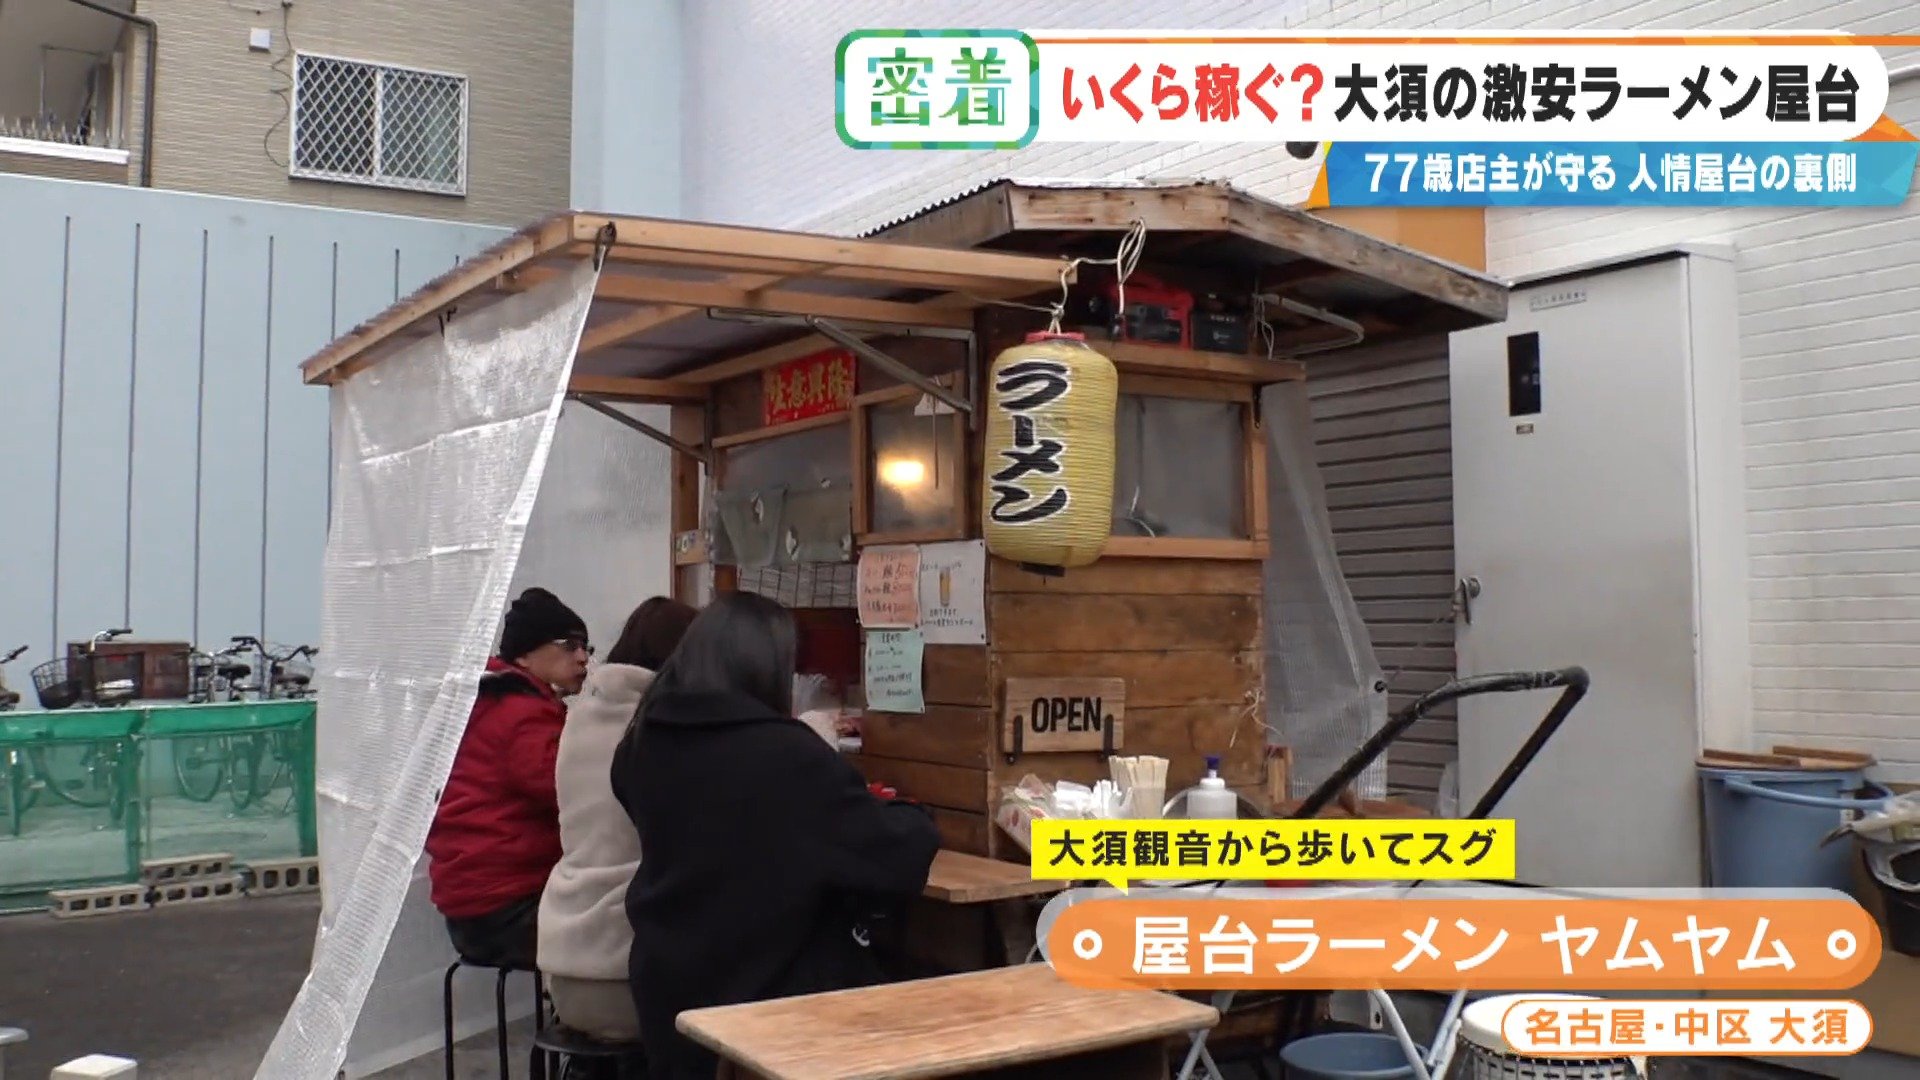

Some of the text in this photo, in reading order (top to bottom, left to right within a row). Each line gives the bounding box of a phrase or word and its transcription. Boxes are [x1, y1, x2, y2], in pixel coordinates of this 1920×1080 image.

[990, 360, 1069, 524] ラーメン
[1031, 696, 1102, 733] OPEN
